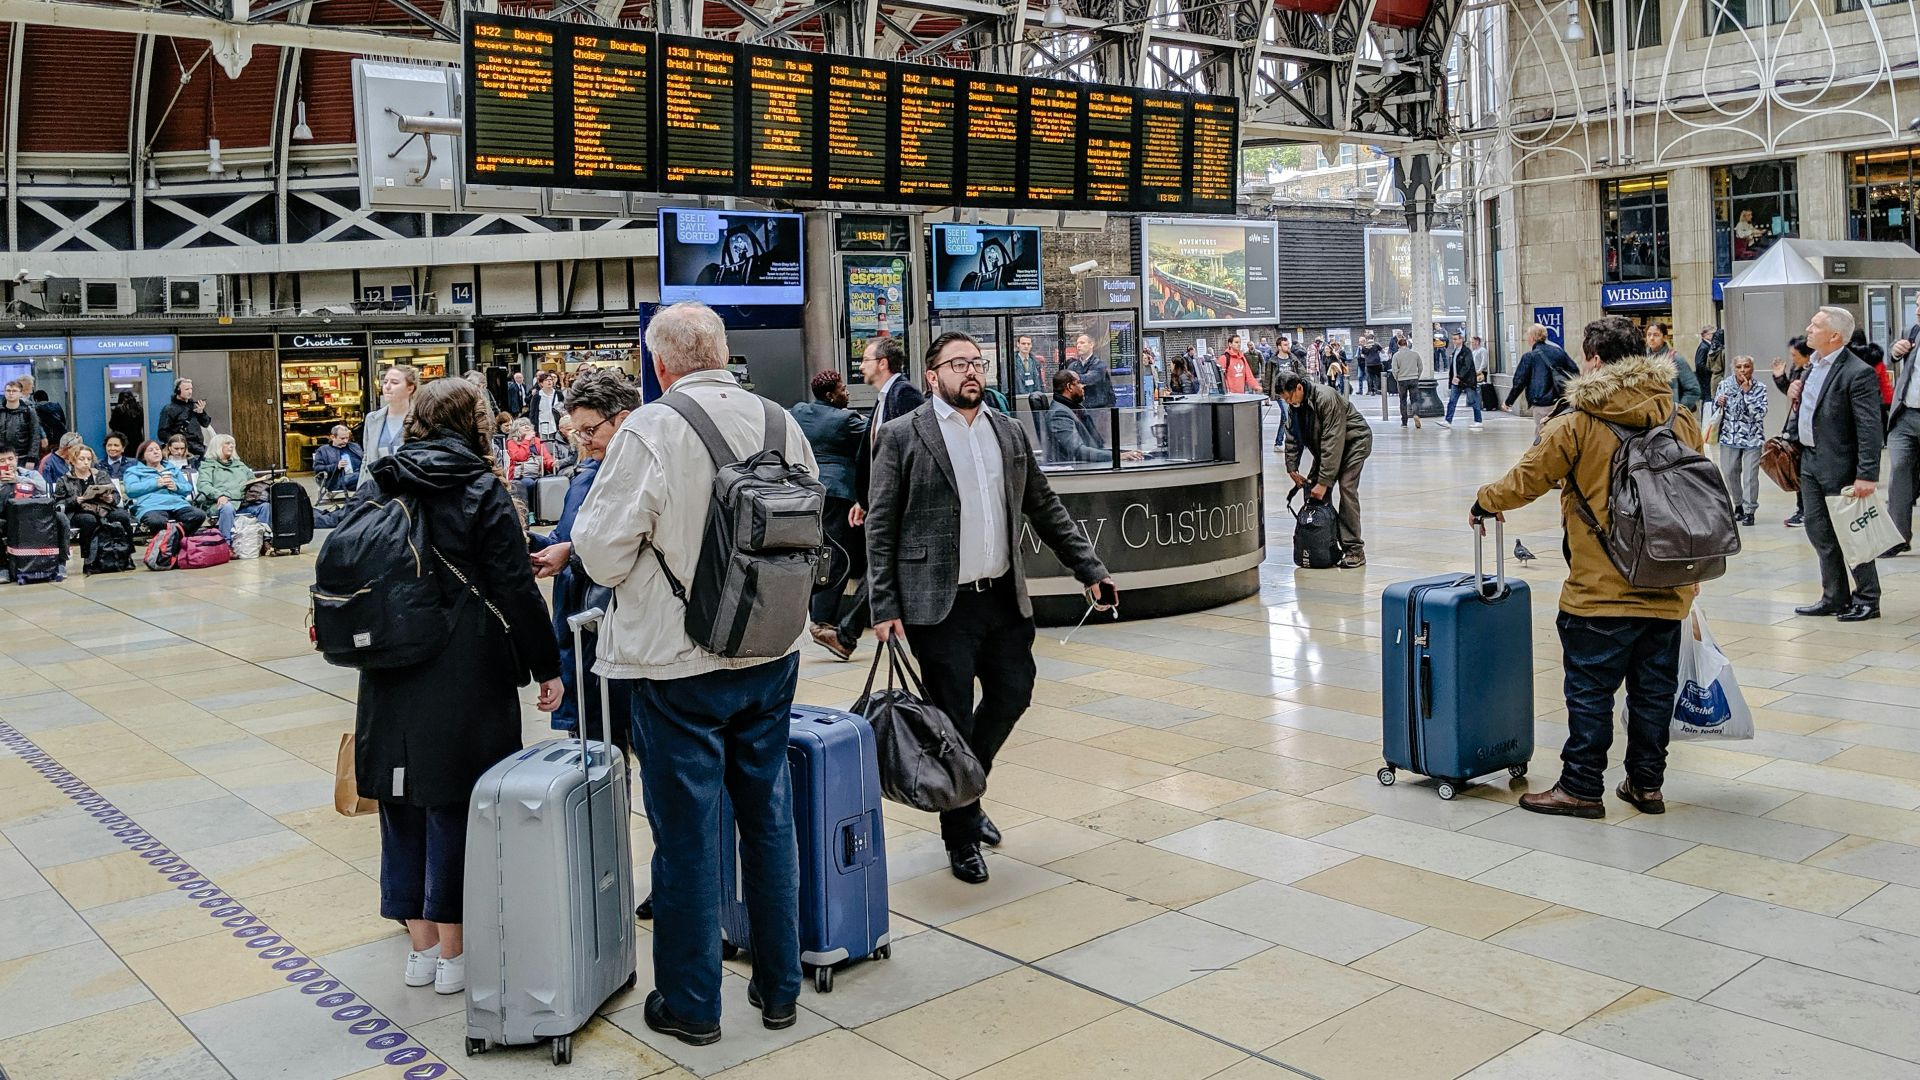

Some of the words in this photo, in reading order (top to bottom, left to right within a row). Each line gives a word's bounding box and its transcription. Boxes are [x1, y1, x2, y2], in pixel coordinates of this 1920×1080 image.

[476, 26, 500, 36] 13:22
[514, 29, 552, 43] Boarding
[574, 36, 597, 47] 13:27
[610, 40, 646, 54] Boarding
[573, 49, 605, 61] Cholsey
[668, 47, 689, 58] 13:30
[696, 50, 733, 64] Preparing
[667, 59, 693, 70] Bristol
[696, 62, 702, 70] T
[704, 63, 727, 73] Meads
[752, 57, 773, 67] 13:33
[751, 69, 786, 80] Heathrow
[830, 66, 849, 75] 13:36
[492, 73, 527, 82] Charlbury
[903, 74, 920, 83] 13:42
[602, 83, 636, 92] Harlington
[830, 77, 866, 88] Cheltenham
[868, 82, 880, 90] Spa
[970, 81, 986, 90] 13:45
[902, 85, 928, 95] Twyford
[1032, 88, 1047, 96] 13:47
[574, 105, 600, 113] Langley
[574, 121, 611, 130] Maidenhead
[680, 214, 696, 222] SEE
[680, 223, 695, 231] SAY
[680, 232, 717, 241] SORTED.
[850, 273, 901, 287] escape
[1104, 280, 1135, 292] Paddington
[367, 290, 381, 302] 12
[454, 286, 470, 299] 14
[1110, 292, 1130, 302] Station
[1606, 286, 1668, 301] WHSmith
[852, 300, 875, 311] YOUR
[1536, 314, 1561, 326] WH
[1680, 725, 1698, 734] Join
